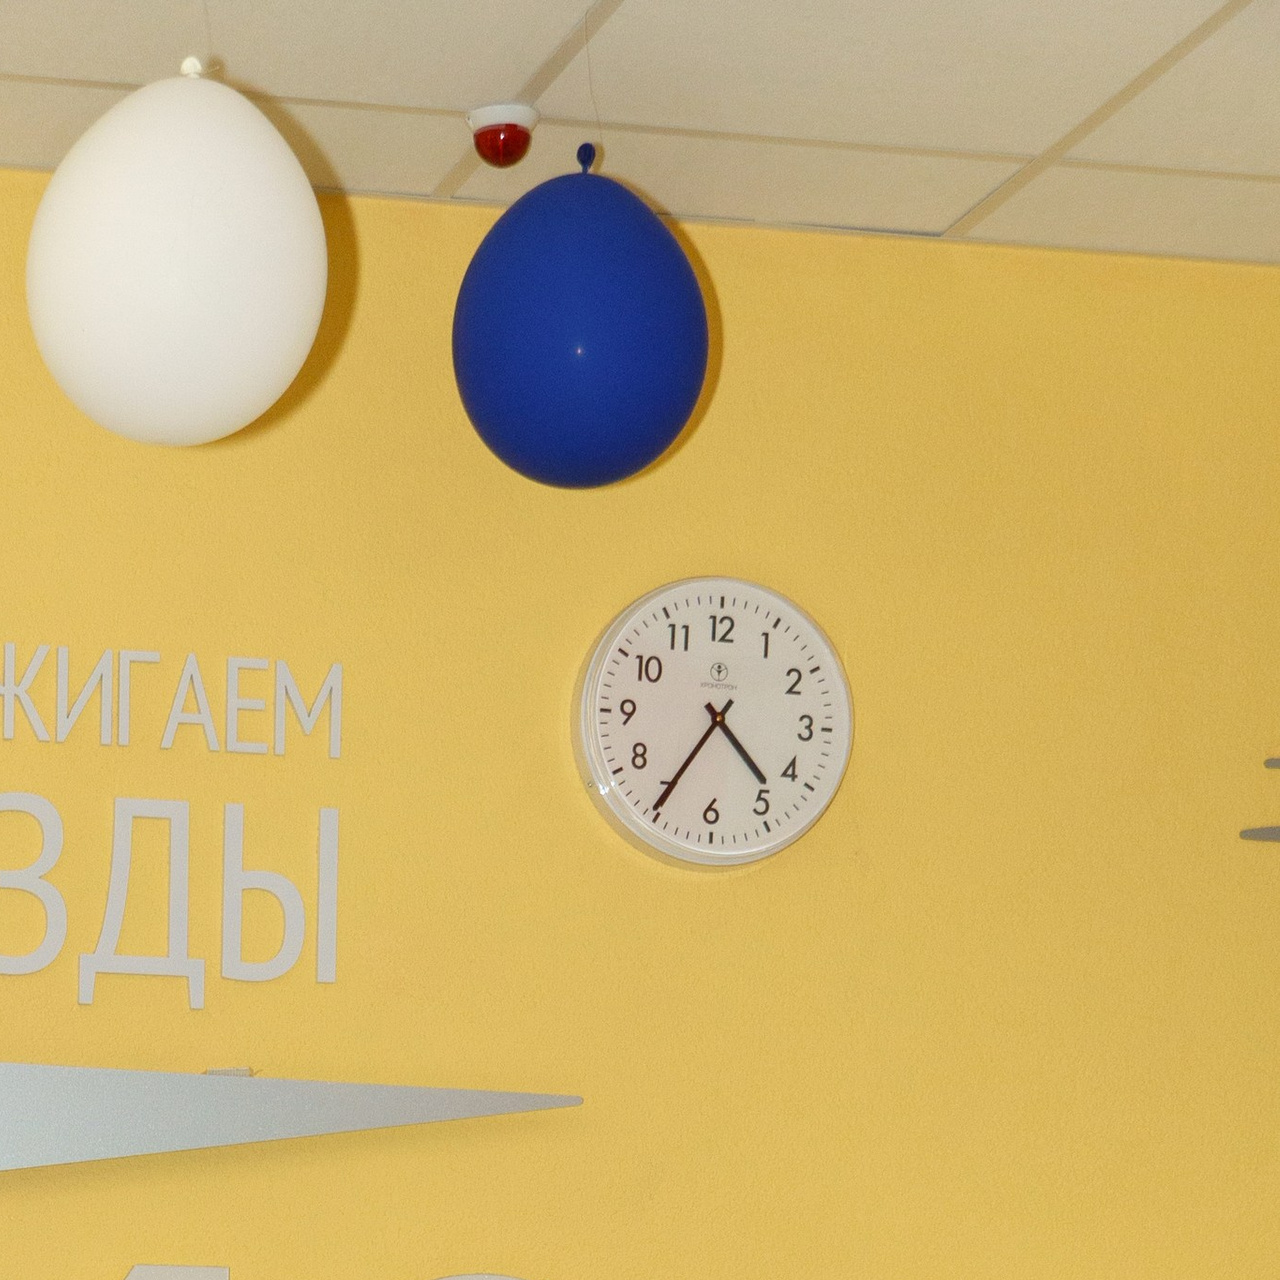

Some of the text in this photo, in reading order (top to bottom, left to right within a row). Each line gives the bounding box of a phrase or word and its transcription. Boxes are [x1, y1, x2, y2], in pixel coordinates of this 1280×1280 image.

[668, 623, 690, 651] 11
[709, 615, 735, 643] 12
[761, 632, 770, 659] 1
[635, 655, 663, 683] 10
[785, 668, 803, 695] 2
[620, 699, 637, 726] 9
[797, 714, 814, 742] 3
[631, 742, 648, 769] 8
[780, 755, 798, 782] 4
[703, 798, 720, 825] 6
[753, 789, 770, 816] 5
